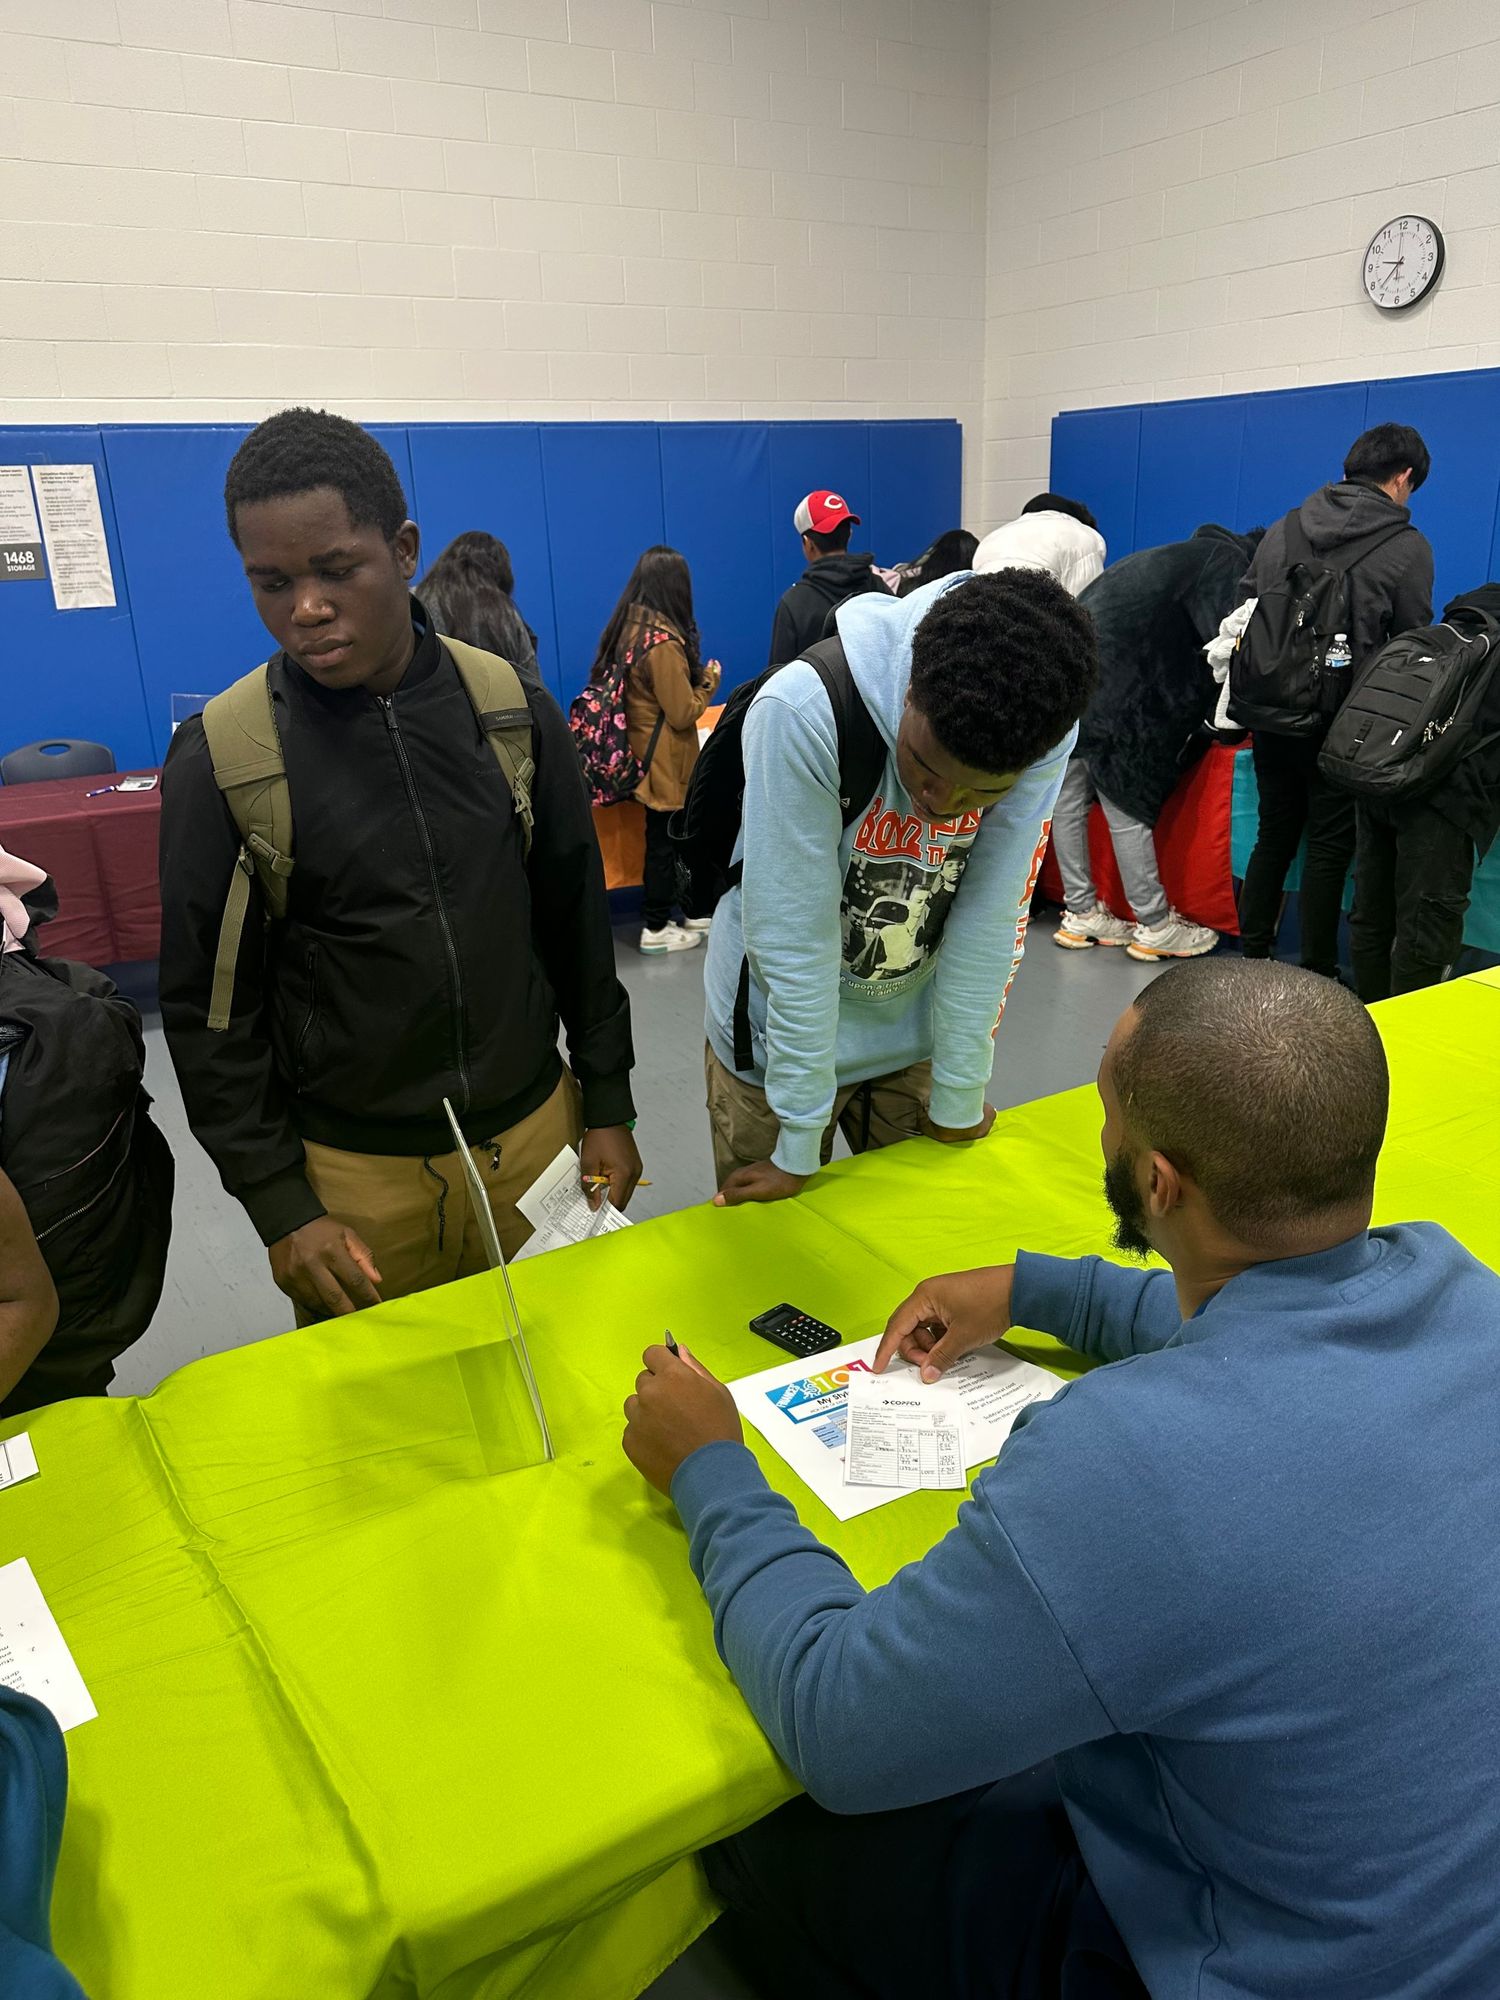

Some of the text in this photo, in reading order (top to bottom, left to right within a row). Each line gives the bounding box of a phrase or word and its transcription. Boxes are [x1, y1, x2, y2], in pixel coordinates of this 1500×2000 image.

[1399, 220, 1408, 230] 12
[1383, 230, 1391, 239] 11
[1426, 234, 1431, 244] 2
[1372, 245, 1380, 254] 10
[1428, 252, 1433, 261] 3
[1368, 264, 1373, 273] 9
[1422, 272, 1428, 281] 4
[1370, 282, 1375, 290] 8
[1410, 288, 1415, 297] 5
[1380, 294, 1384, 302] 7
[1394, 296, 1400, 304] 6
[824, 495, 843, 509] C
[3, 551, 35, 565] 1468
[848, 981, 873, 990] upon
[816, 1396, 832, 1405] My
